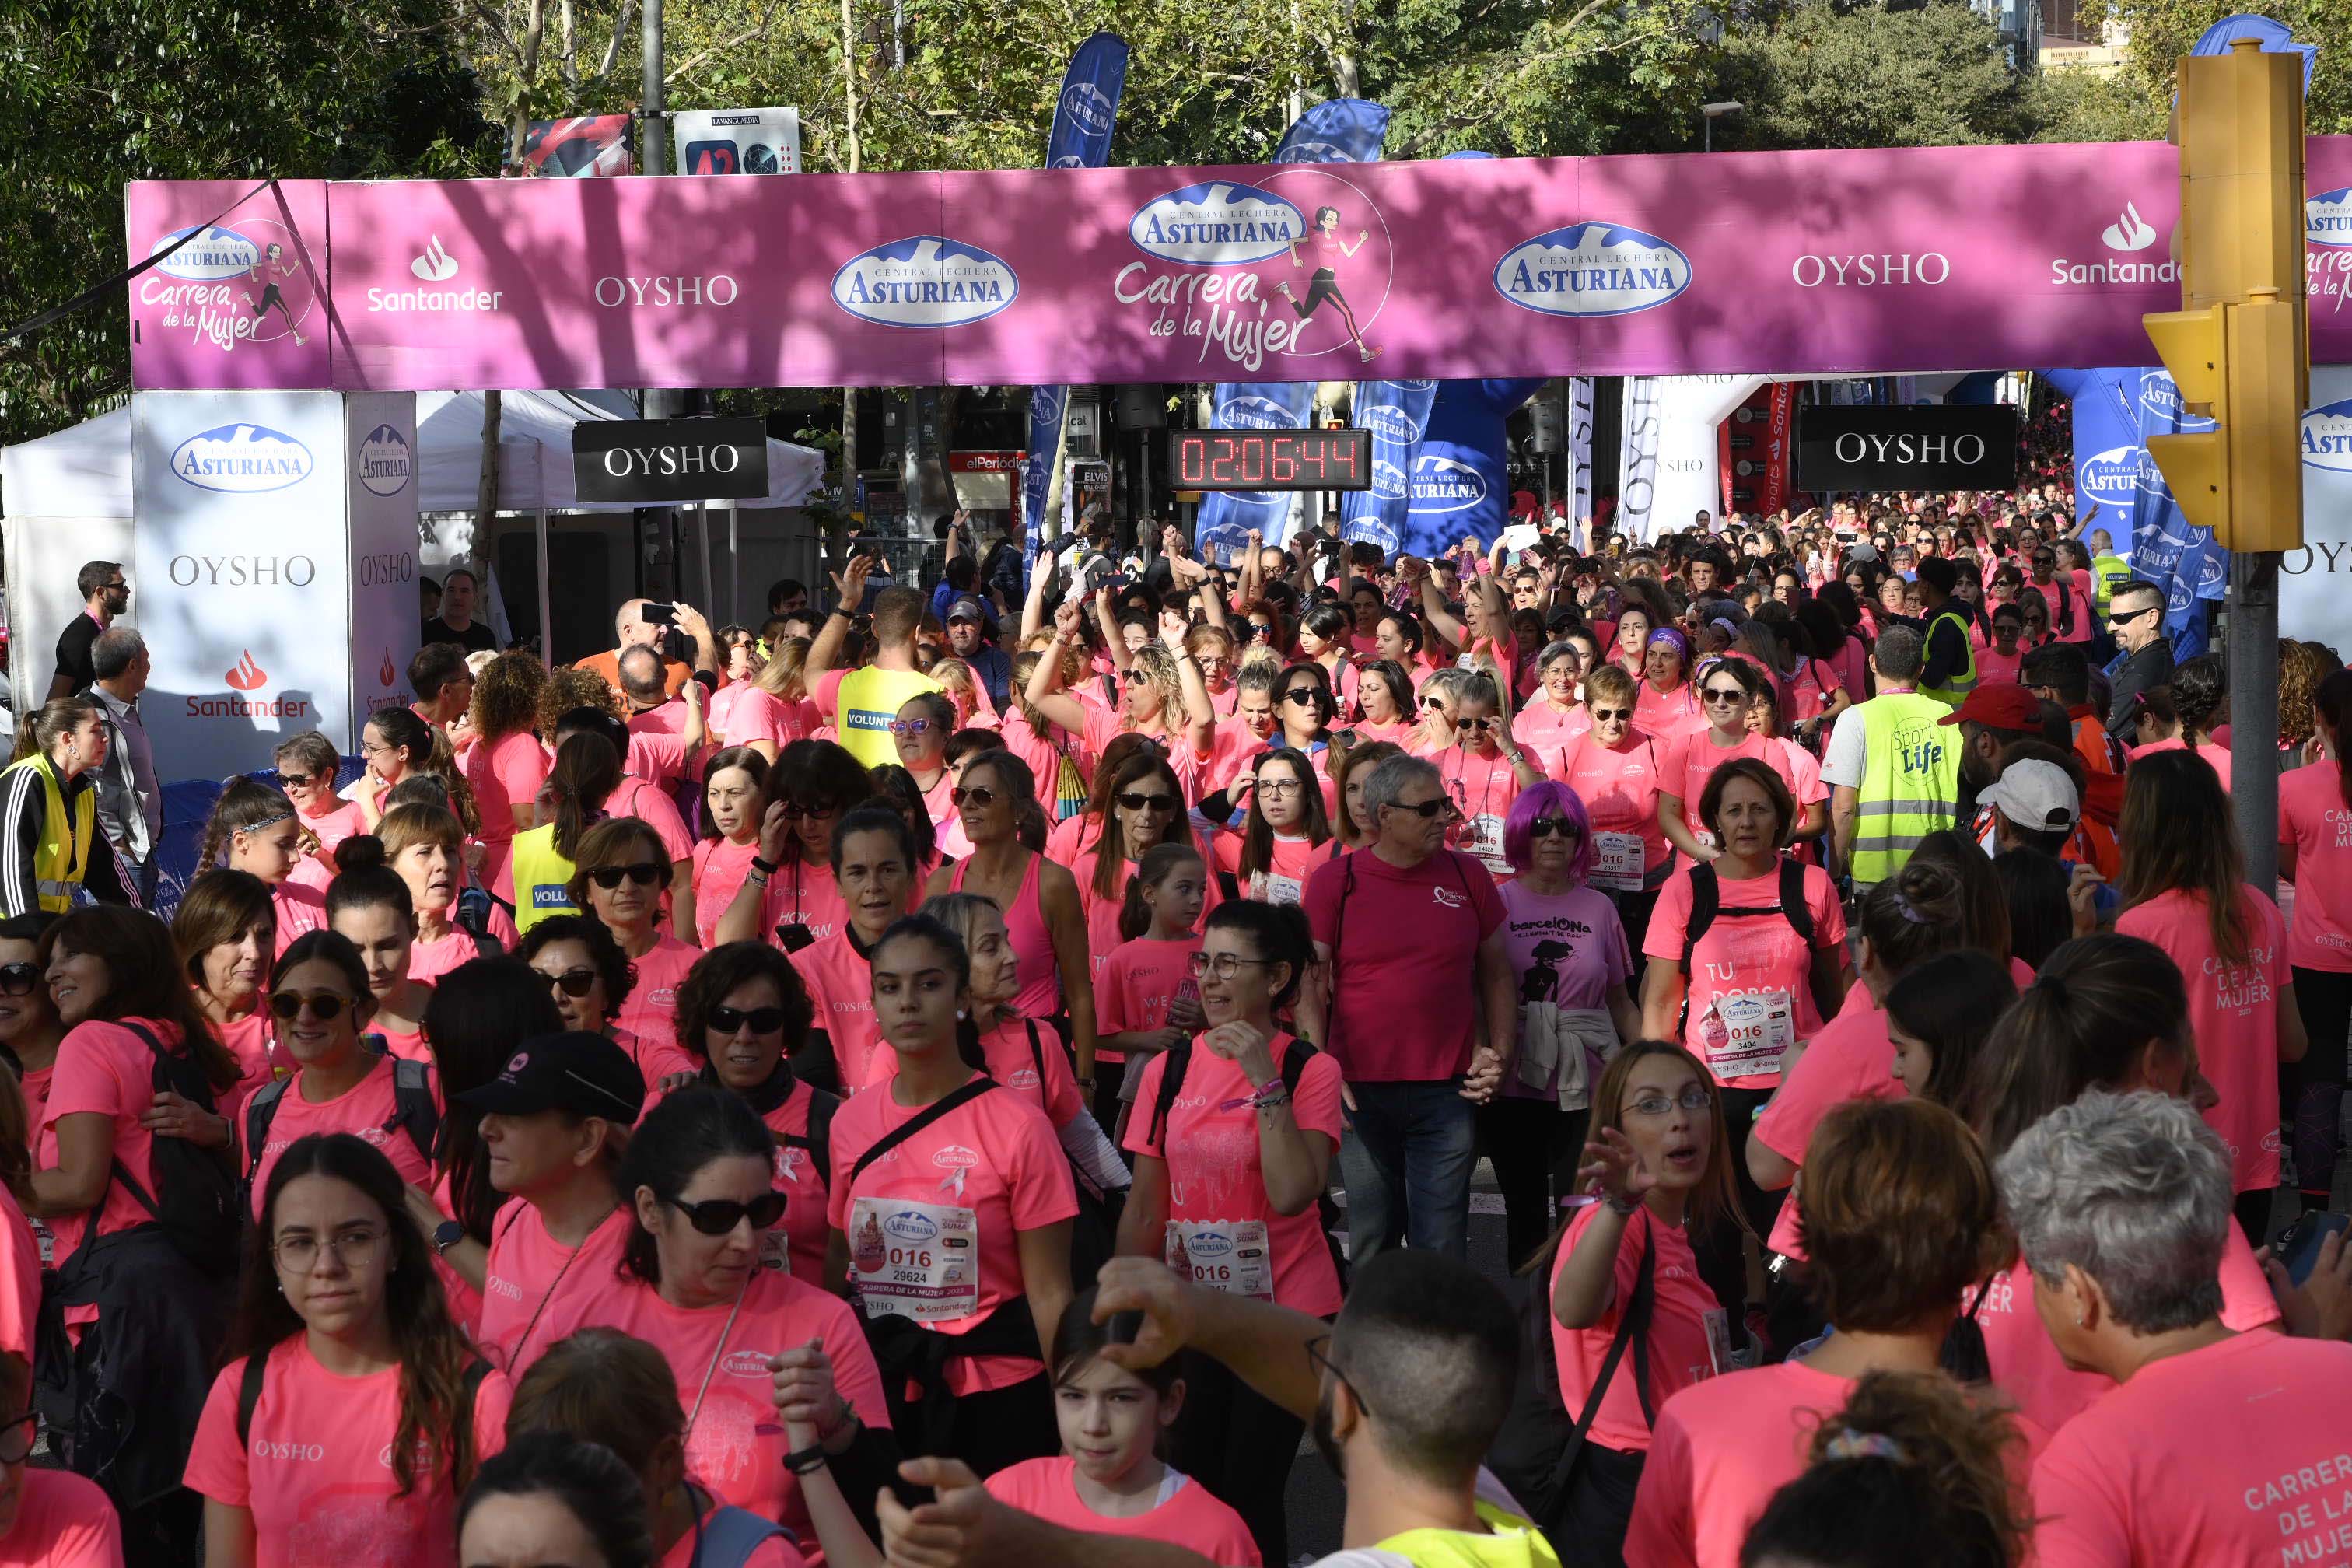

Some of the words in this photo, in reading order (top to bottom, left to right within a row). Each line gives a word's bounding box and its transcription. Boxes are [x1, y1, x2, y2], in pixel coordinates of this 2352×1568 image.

[1170, 210, 1226, 220] CENTRAL
[1230, 208, 1287, 219] LECHERA
[1142, 212, 1292, 246] ASTURIANA
[1538, 254, 1601, 265] CENTRAL
[1607, 253, 1670, 264] LECHERA
[875, 268, 933, 278] CENTRAL
[940, 267, 999, 277] LECHERA
[1509, 257, 1676, 294] ASTURIANA
[1791, 252, 1951, 289] OYSHO
[2051, 257, 2181, 285] Santand
[140, 276, 232, 306] Carrera
[594, 275, 737, 307] OYSHO
[845, 270, 1005, 306] ASTURIANA
[1113, 261, 1258, 305] Carrera
[2323, 274, 2338, 296] la
[367, 286, 503, 313] Santander
[163, 307, 180, 327] de
[184, 307, 195, 327] la
[193, 303, 267, 352] Mujer
[1150, 307, 1177, 338] de
[1182, 307, 1202, 337] la
[1198, 299, 1315, 373] Mujer
[1181, 438, 1355, 481] 02:06:44
[1834, 432, 1986, 465] OYSHO
[181, 449, 303, 476] ASTURIANA
[362, 451, 408, 479] ASTURIANA
[604, 444, 740, 478] OYSHO
[966, 456, 1024, 470] elPeriódi
[1083, 471, 1108, 481] ELVIS
[1409, 483, 1479, 499] TURIANA
[168, 555, 316, 586] OYSHO
[360, 552, 412, 587] OYSHO
[186, 695, 308, 717] Santander
[849, 713, 893, 726] VOLUNT
[1894, 723, 1934, 751] Sport
[1902, 741, 1943, 775] Life
[1602, 854, 1624, 863] 016
[534, 891, 569, 901] VOLU
[778, 911, 812, 925] HOY
[1705, 961, 1734, 982] TU
[2217, 970, 2238, 992] DE
[2215, 984, 2271, 1010] MUJER
[1727, 1007, 1762, 1018] ASTURIANA
[1731, 1025, 1762, 1041] 016
[1738, 1041, 1757, 1050] 3494
[936, 1153, 976, 1164] ASTURIANA
[888, 1221, 933, 1235] ASTURIANA
[1190, 1241, 1229, 1251] ASTURIANA
[889, 1248, 932, 1267] 016
[893, 1270, 927, 1283] 29624
[1195, 1265, 1230, 1280] 016
[488, 1275, 523, 1302] OYSHO
[926, 1303, 968, 1314] Santander
[255, 1440, 324, 1462] OYSHO
[2278, 1503, 2315, 1537] DE
